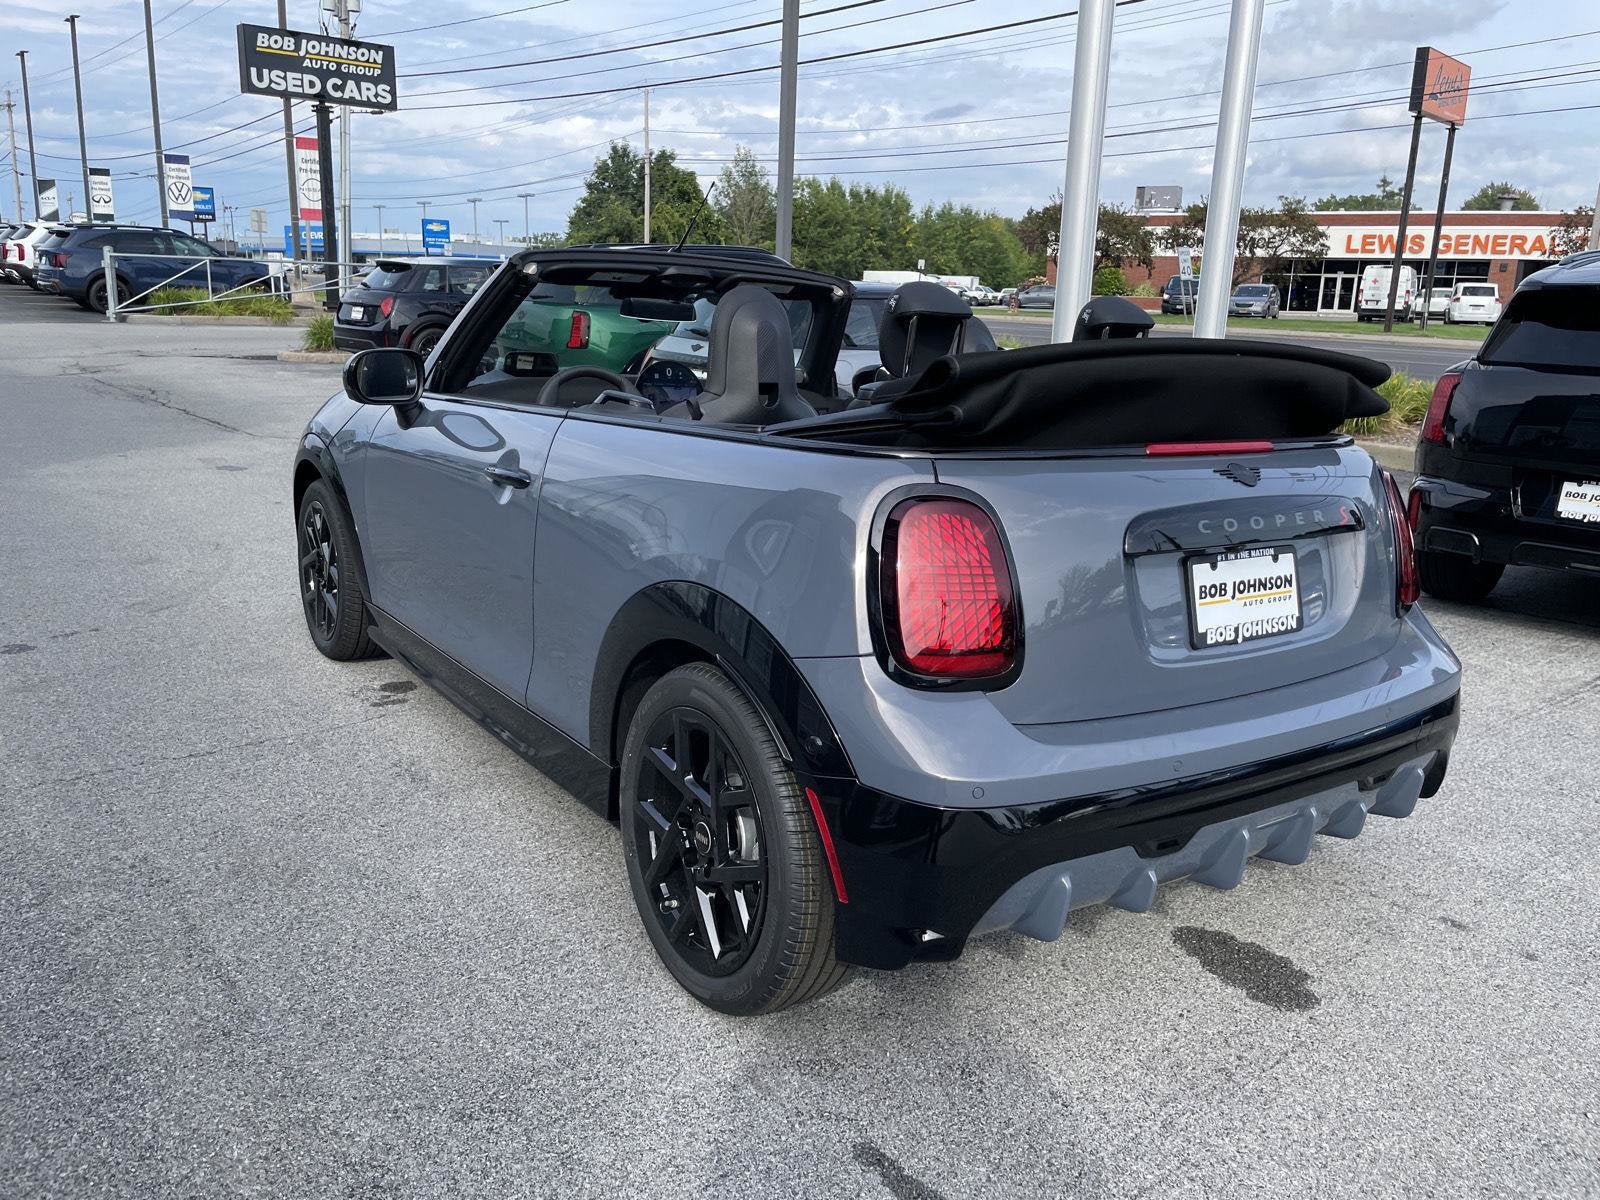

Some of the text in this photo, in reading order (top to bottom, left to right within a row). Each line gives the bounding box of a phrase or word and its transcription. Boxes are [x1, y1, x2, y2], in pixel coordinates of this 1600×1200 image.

[256, 33, 384, 64] BOB JOHNSON
[303, 58, 382, 77] AUTO GROUP
[250, 66, 392, 105] USED CARS
[1345, 234, 1426, 254] LEWIS
[1181, 265, 1192, 276] 40
[1564, 490, 1588, 500] BOB
[1198, 505, 1350, 534] COOPER S
[1560, 510, 1583, 520] BOB
[1227, 553, 1236, 561] IN
[1237, 550, 1250, 559] THE
[1250, 547, 1275, 558] NATION
[1199, 573, 1293, 600] BOB JOHNSON
[1242, 594, 1293, 608] AUTO GROUP
[1206, 613, 1298, 645] BOB JOHNSON
